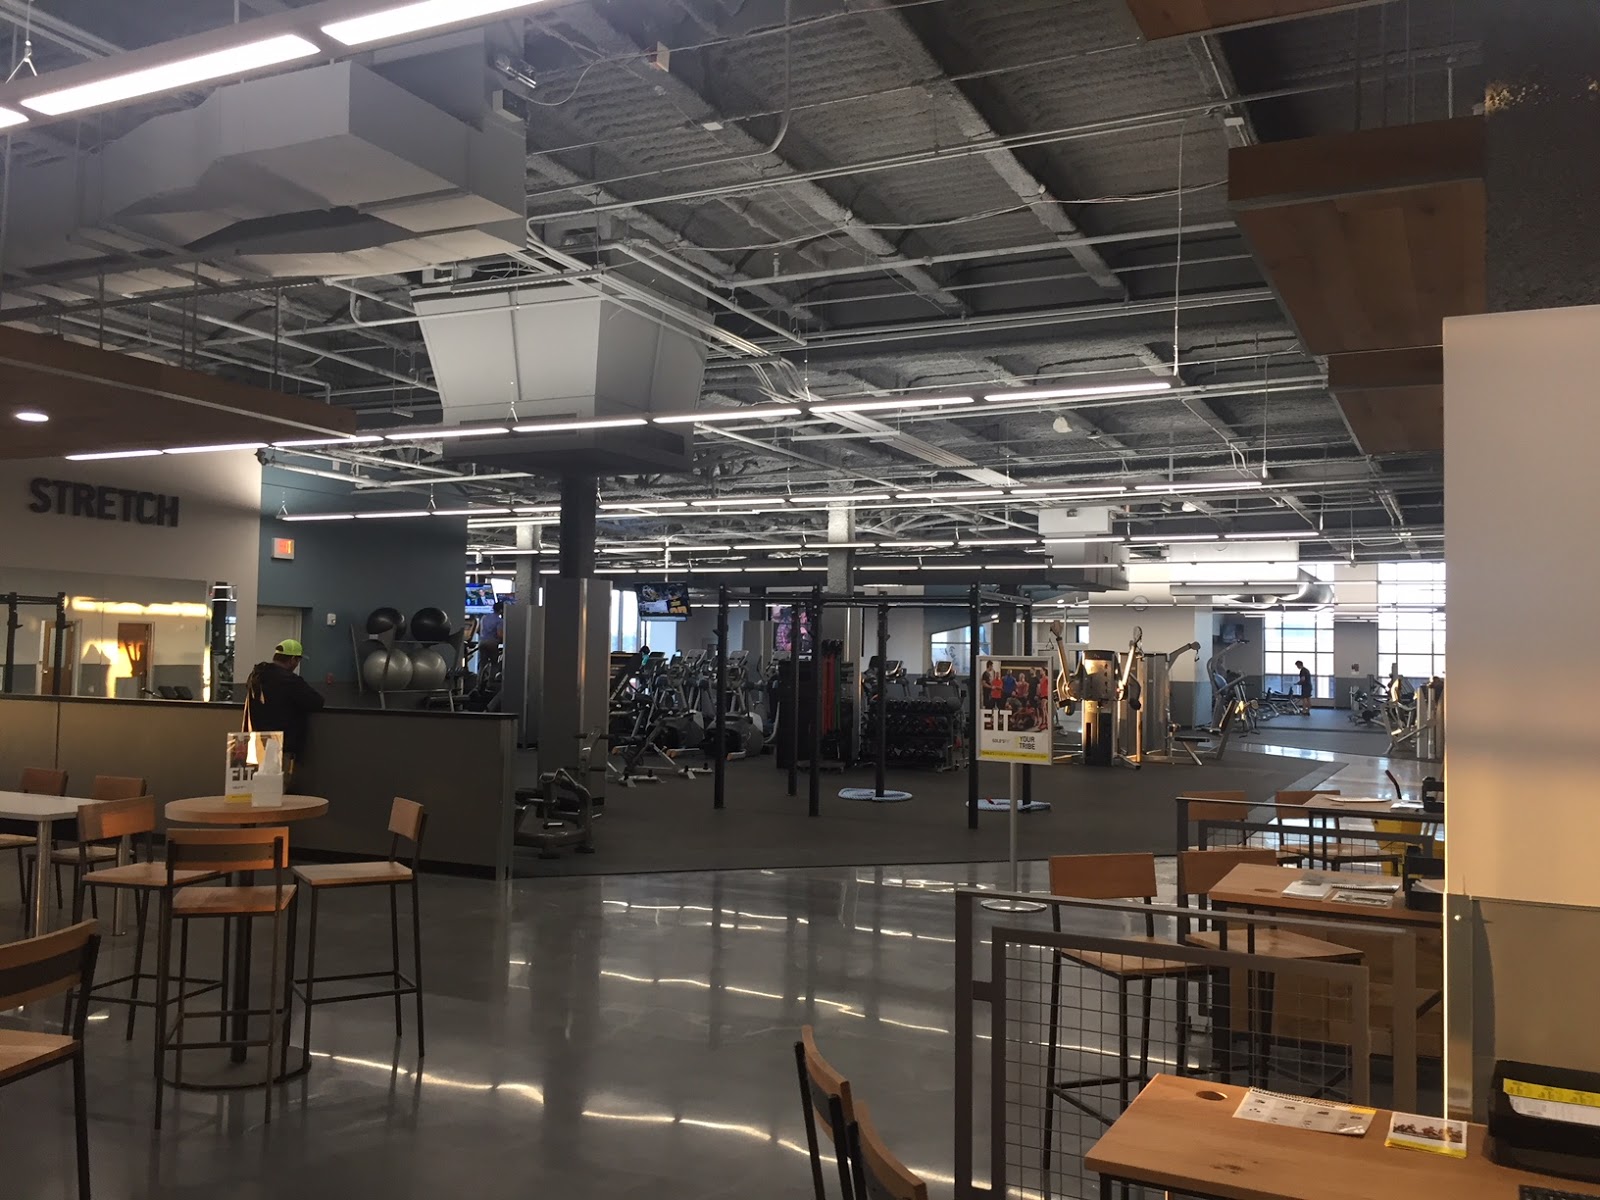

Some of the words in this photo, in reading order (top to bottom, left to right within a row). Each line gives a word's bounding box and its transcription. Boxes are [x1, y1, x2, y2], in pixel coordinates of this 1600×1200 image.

[29, 477, 180, 527] STRETCH
[980, 709, 1013, 732] FIT
[1019, 735, 1036, 743] YOUR
[1019, 742, 1036, 750] TRIBE
[229, 767, 255, 781] FIT
